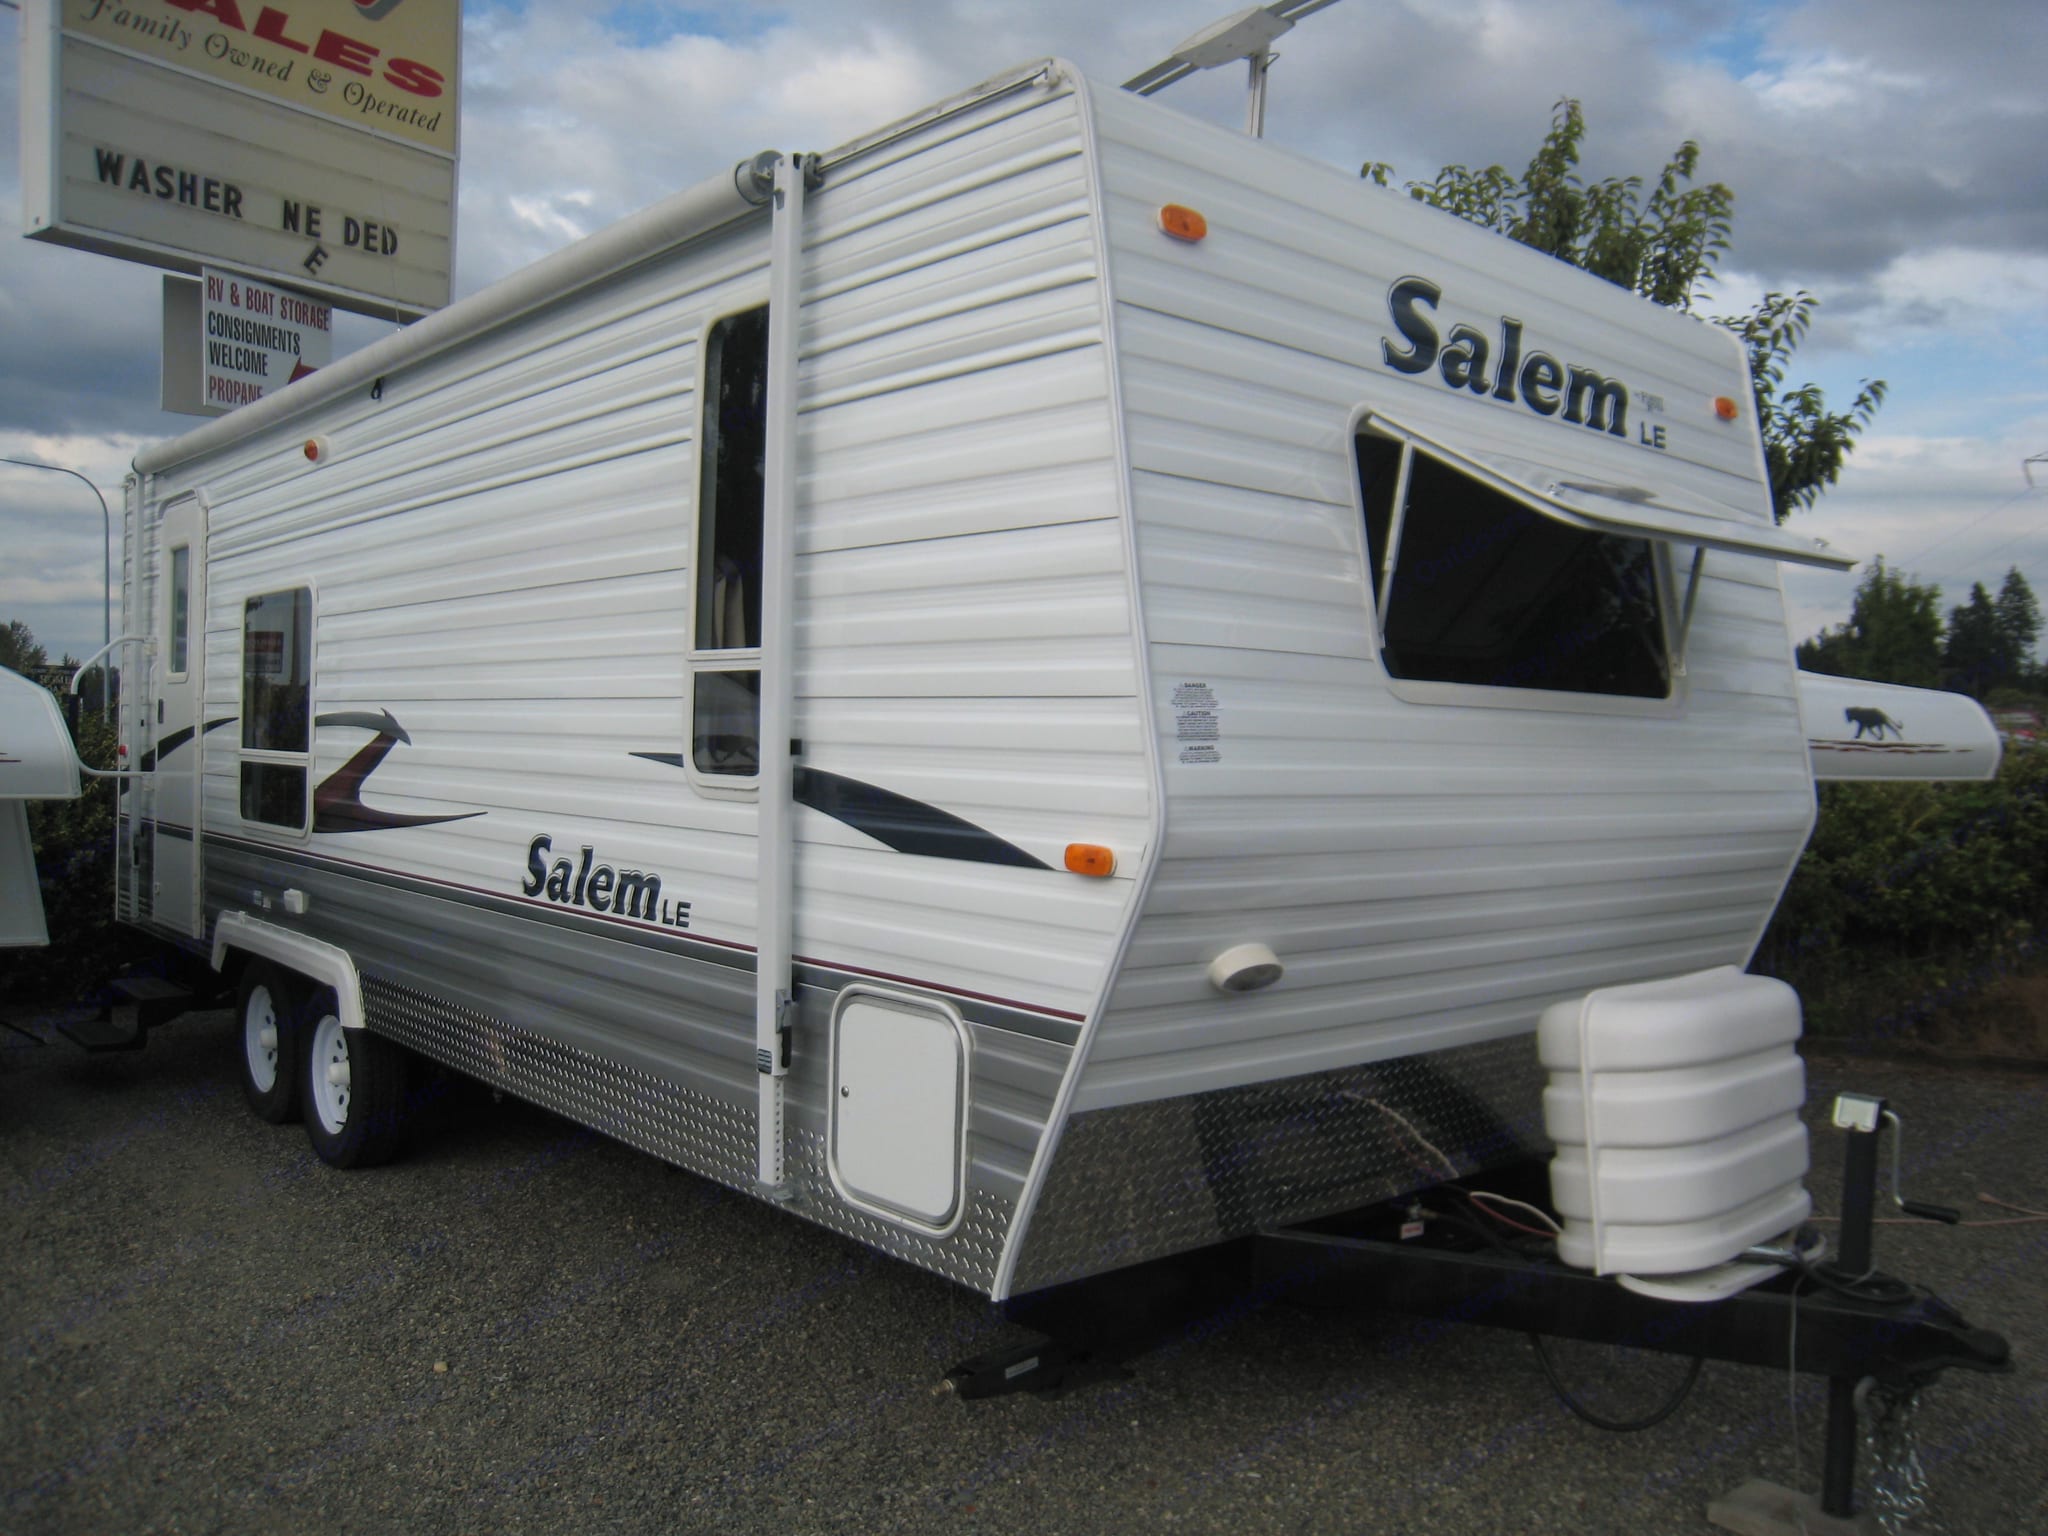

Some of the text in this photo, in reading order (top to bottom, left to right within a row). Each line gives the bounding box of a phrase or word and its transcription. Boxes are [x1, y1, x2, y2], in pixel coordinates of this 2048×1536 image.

[79, 0, 442, 133] Family Owned & Operated
[165, 0, 445, 98] ALES
[95, 148, 243, 218] WASHER
[208, 275, 329, 331] RV & BOAT STORAGE
[208, 310, 301, 356] CONSIGNMENTS
[209, 340, 268, 377] WELCOME
[1381, 275, 1667, 449] Salem LE
[522, 833, 692, 928] Salem LE
